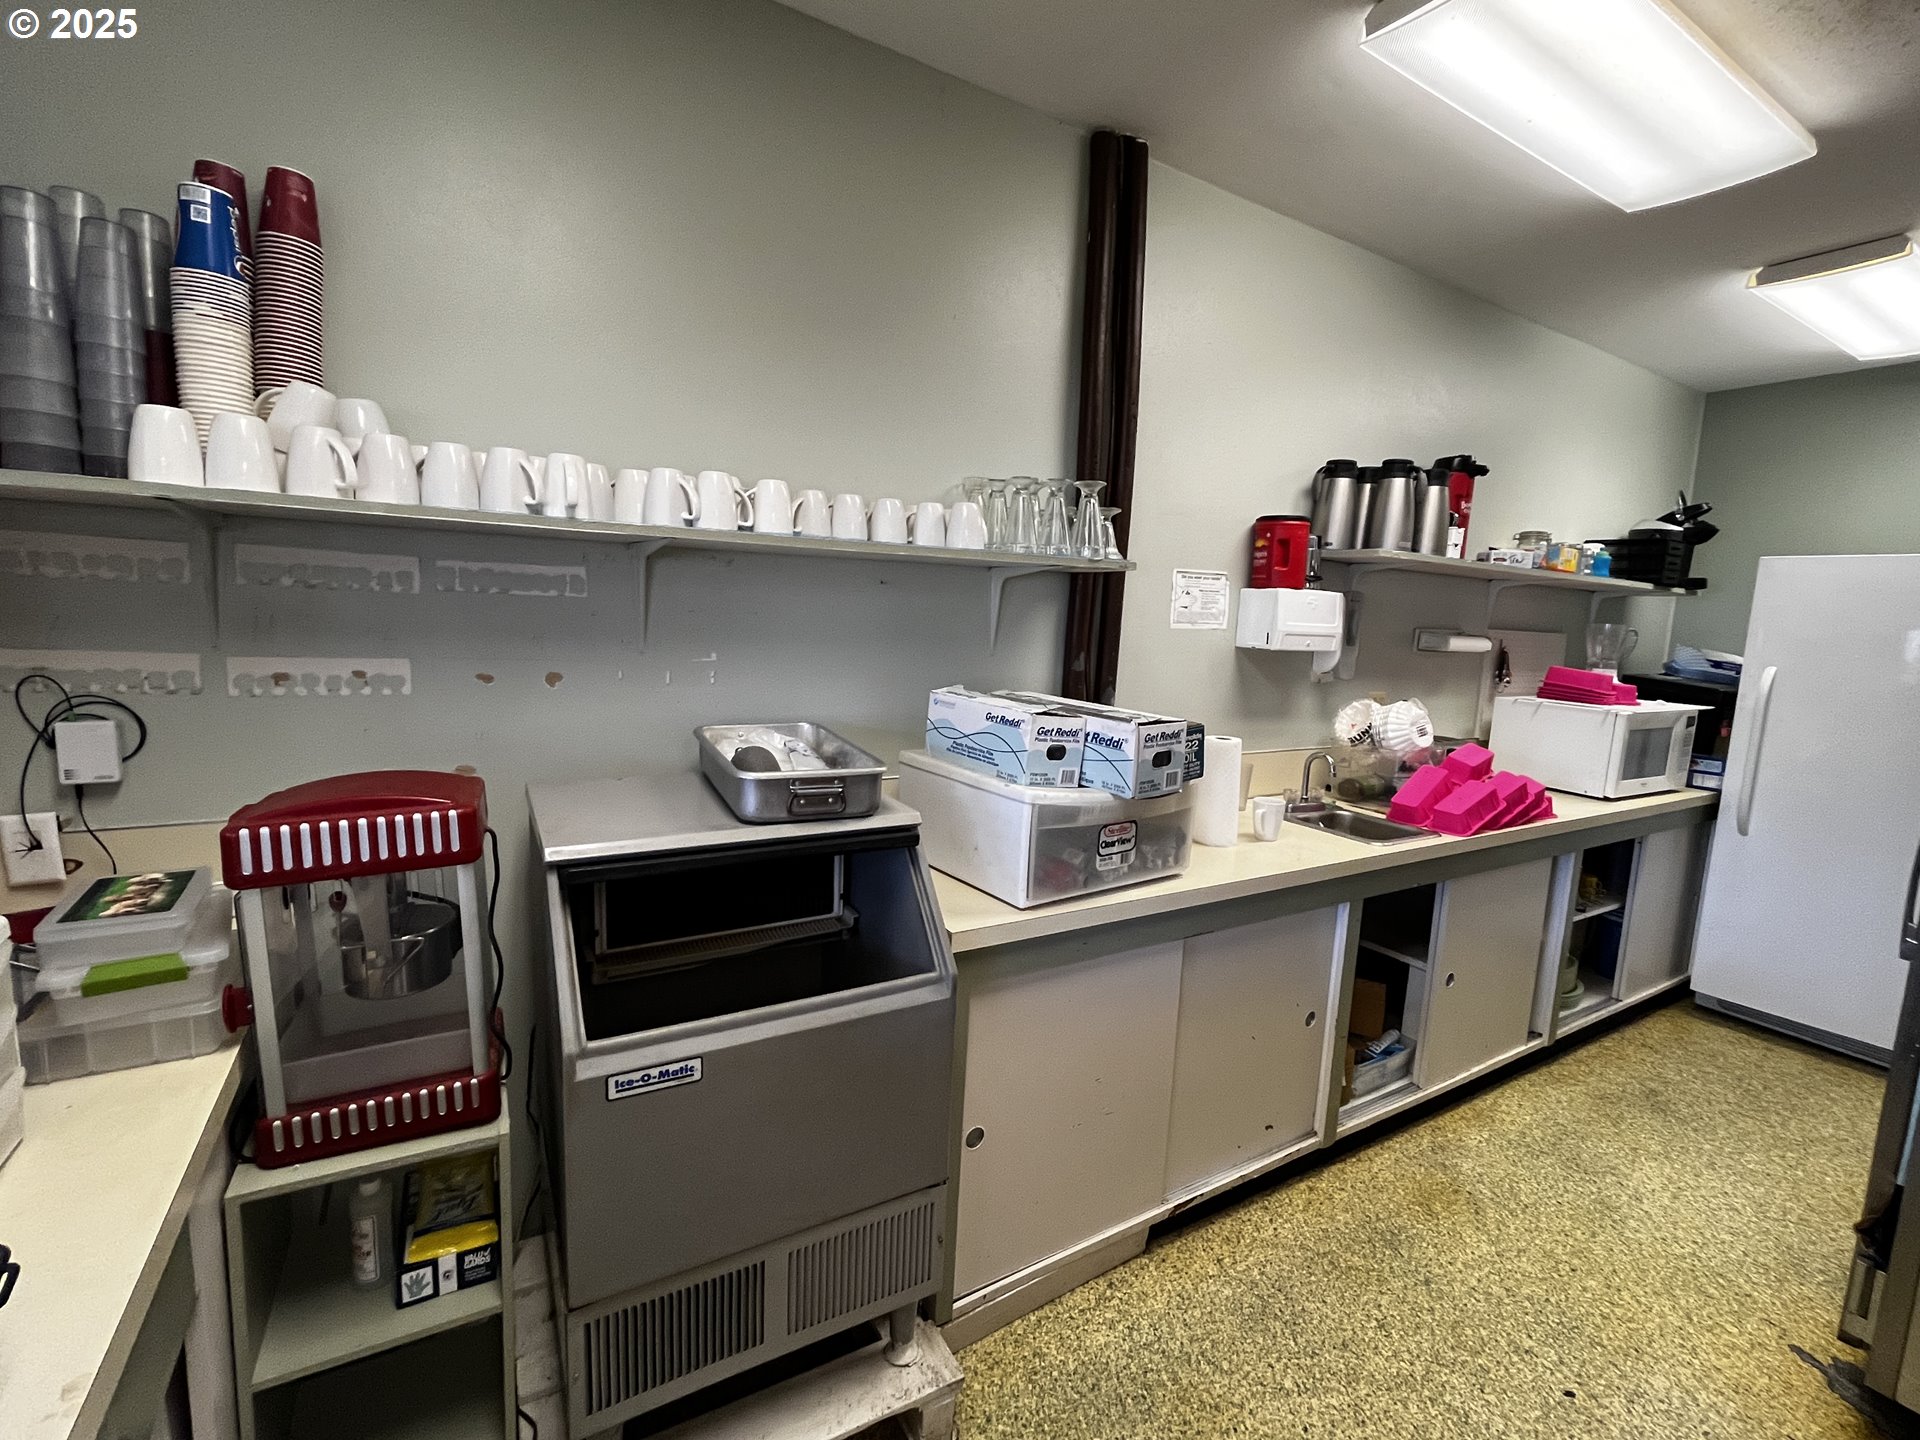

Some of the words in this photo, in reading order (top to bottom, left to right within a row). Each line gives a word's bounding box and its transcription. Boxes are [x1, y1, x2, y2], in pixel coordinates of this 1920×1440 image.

[985, 712, 1000, 722] Get
[1000, 715, 1022, 728] Reddi
[1037, 726, 1055, 737] Get
[1055, 727, 1079, 737] Reddi
[1145, 733, 1159, 743] Get
[1160, 730, 1181, 741] Reddi
[1091, 732, 1125, 749] Reddi
[1184, 752, 1197, 764] OIL
[614, 1063, 695, 1090] Ice-O-Matic
